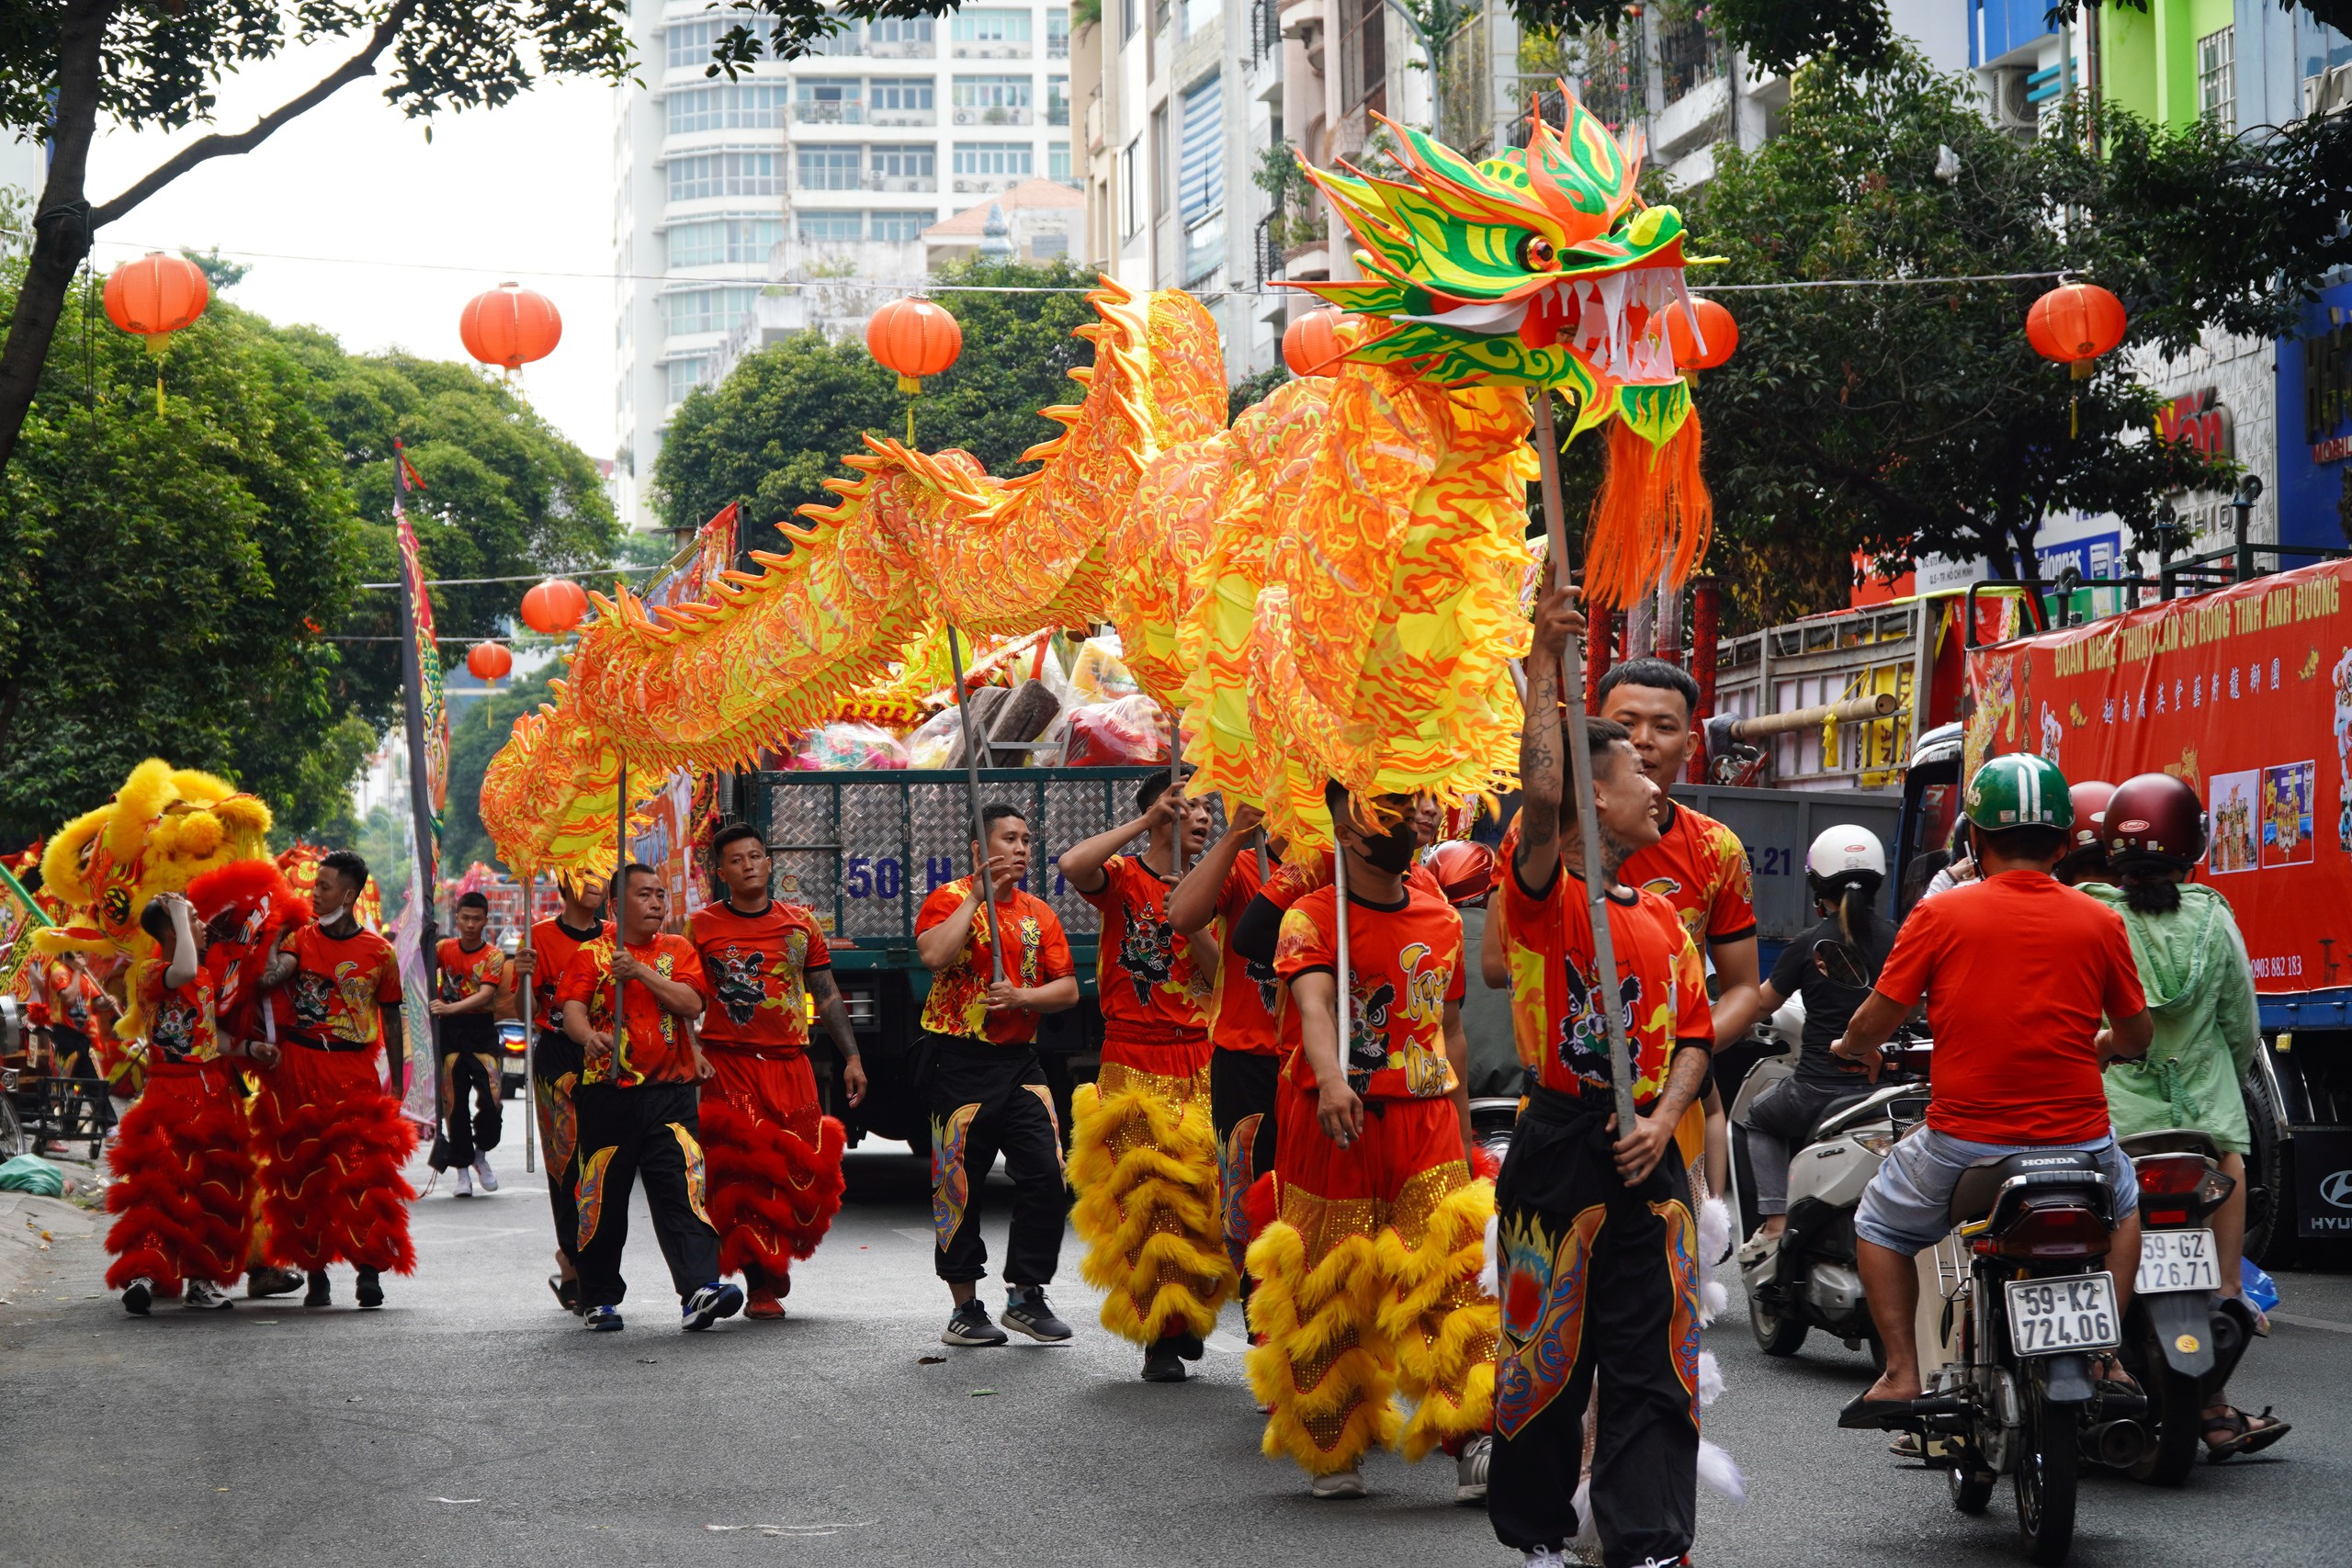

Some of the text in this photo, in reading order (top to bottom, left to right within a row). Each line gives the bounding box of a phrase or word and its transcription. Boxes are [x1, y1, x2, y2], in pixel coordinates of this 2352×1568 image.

[2035, 549, 2083, 581] alonpas
[2234, 594, 2263, 636] TINH
[2266, 587, 2292, 628] ANH
[2295, 571, 2340, 623] ĐƯỜNG
[848, 858, 903, 898] 50
[2251, 955, 2302, 978] 0903 882 183
[2021, 1157, 2079, 1167] HONDA
[2312, 1217, 2352, 1229] HYU
[2143, 1235, 2204, 1259] 59-G2
[2140, 1261, 2212, 1289] 126.71
[2025, 1282, 2099, 1316] 59-K2
[2022, 1313, 2110, 1348] 724.06
